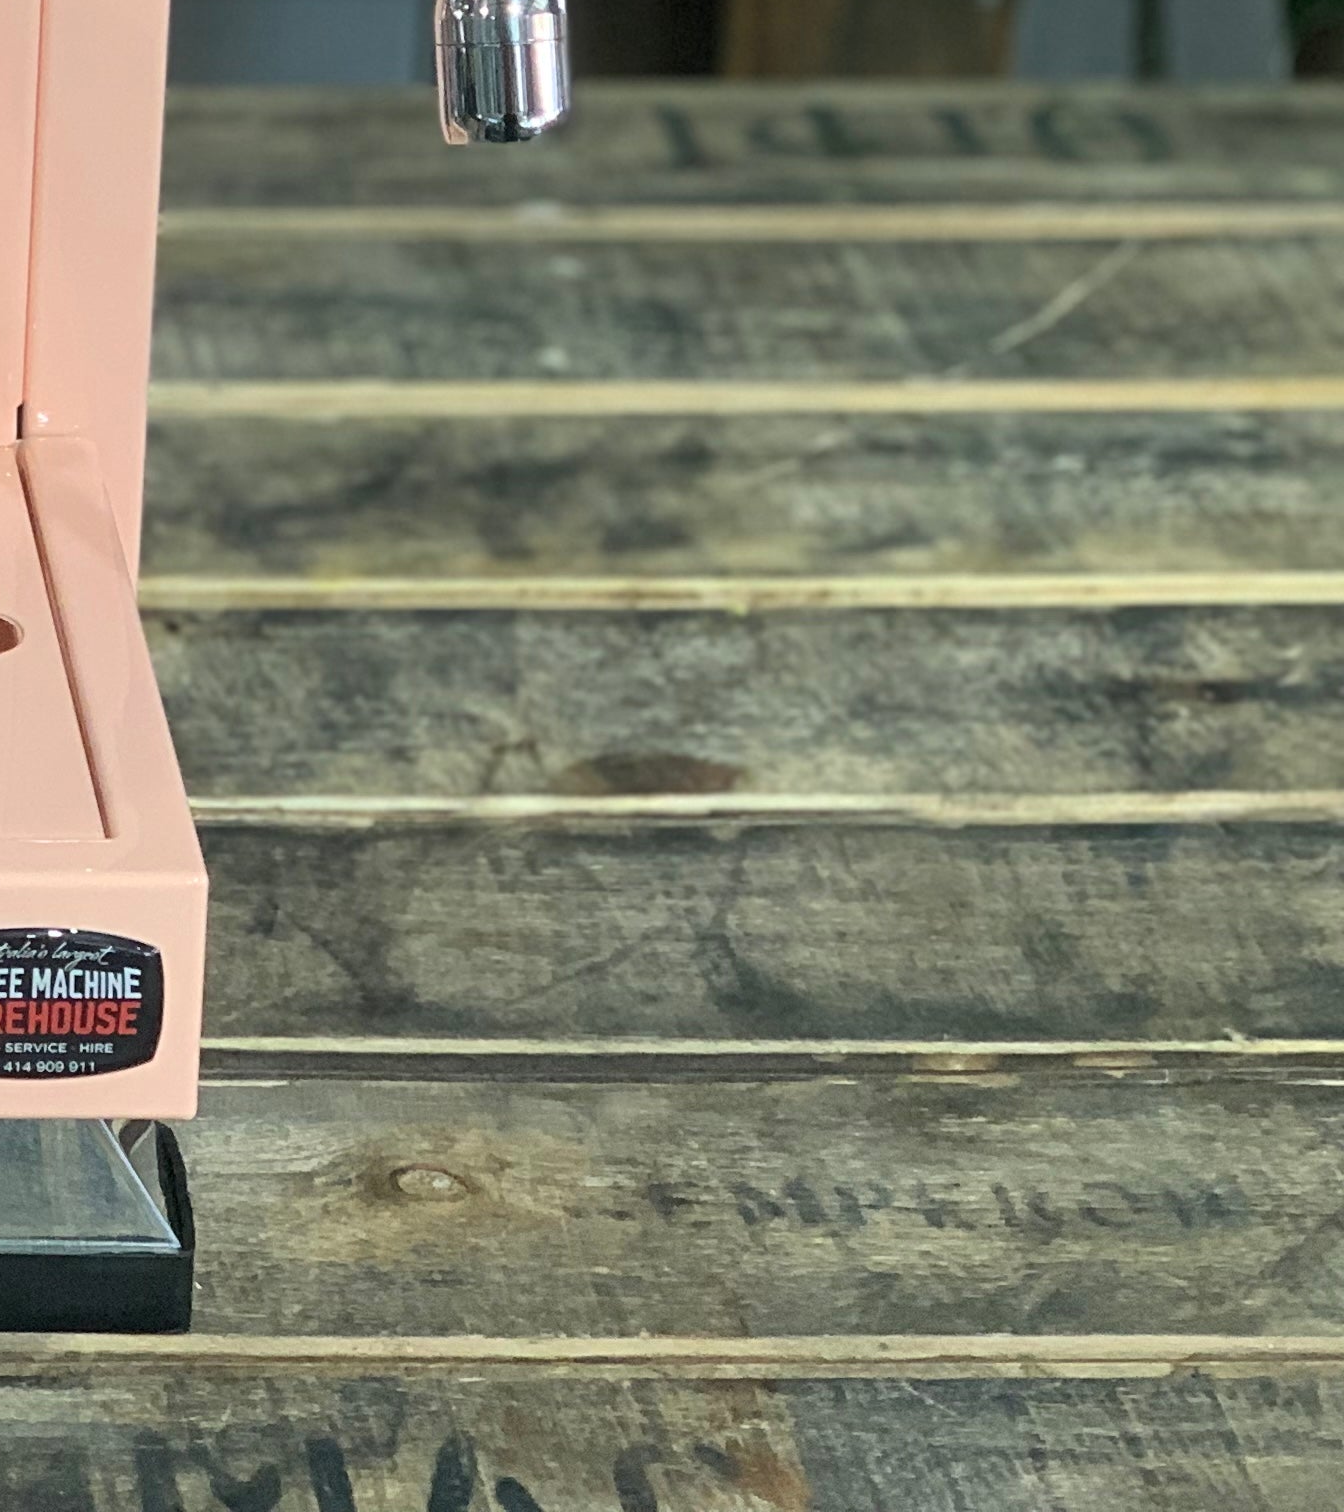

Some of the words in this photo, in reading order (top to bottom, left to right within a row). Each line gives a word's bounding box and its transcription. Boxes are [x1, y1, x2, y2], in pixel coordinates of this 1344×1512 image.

[31, 966, 143, 999] MACHINE
[4, 1042, 67, 1054] SERVICE
[78, 1042, 114, 1054] HIRE
[3, 1060, 31, 1073] 414
[36, 1060, 65, 1073] 909
[69, 1060, 96, 1073] 911
